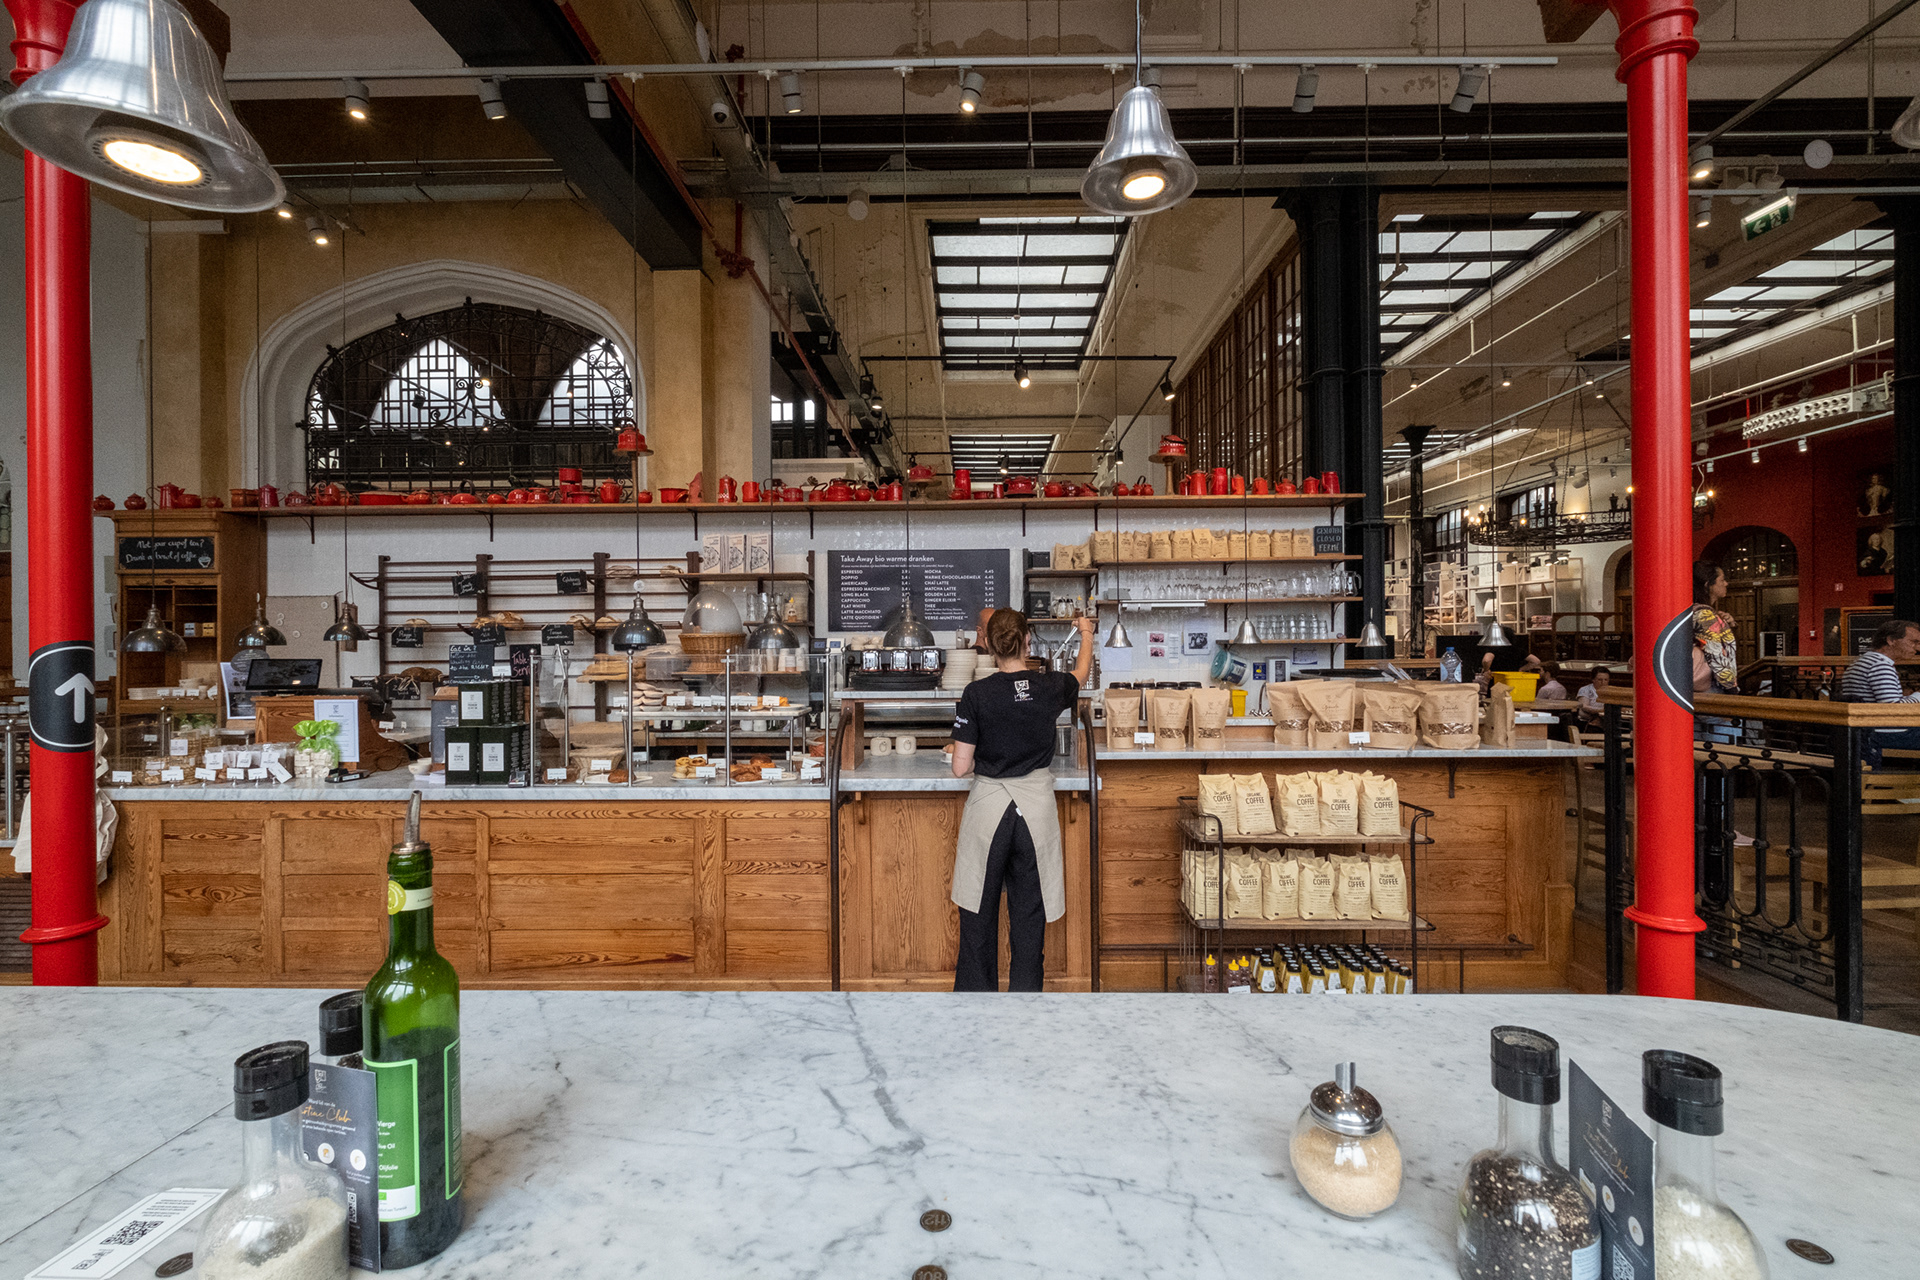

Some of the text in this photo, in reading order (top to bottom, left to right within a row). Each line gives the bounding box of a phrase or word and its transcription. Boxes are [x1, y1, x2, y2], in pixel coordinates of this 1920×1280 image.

[856, 555, 874, 564] Away
[1245, 797, 1265, 805] COFFEE
[326, 1107, 352, 1123] Club
